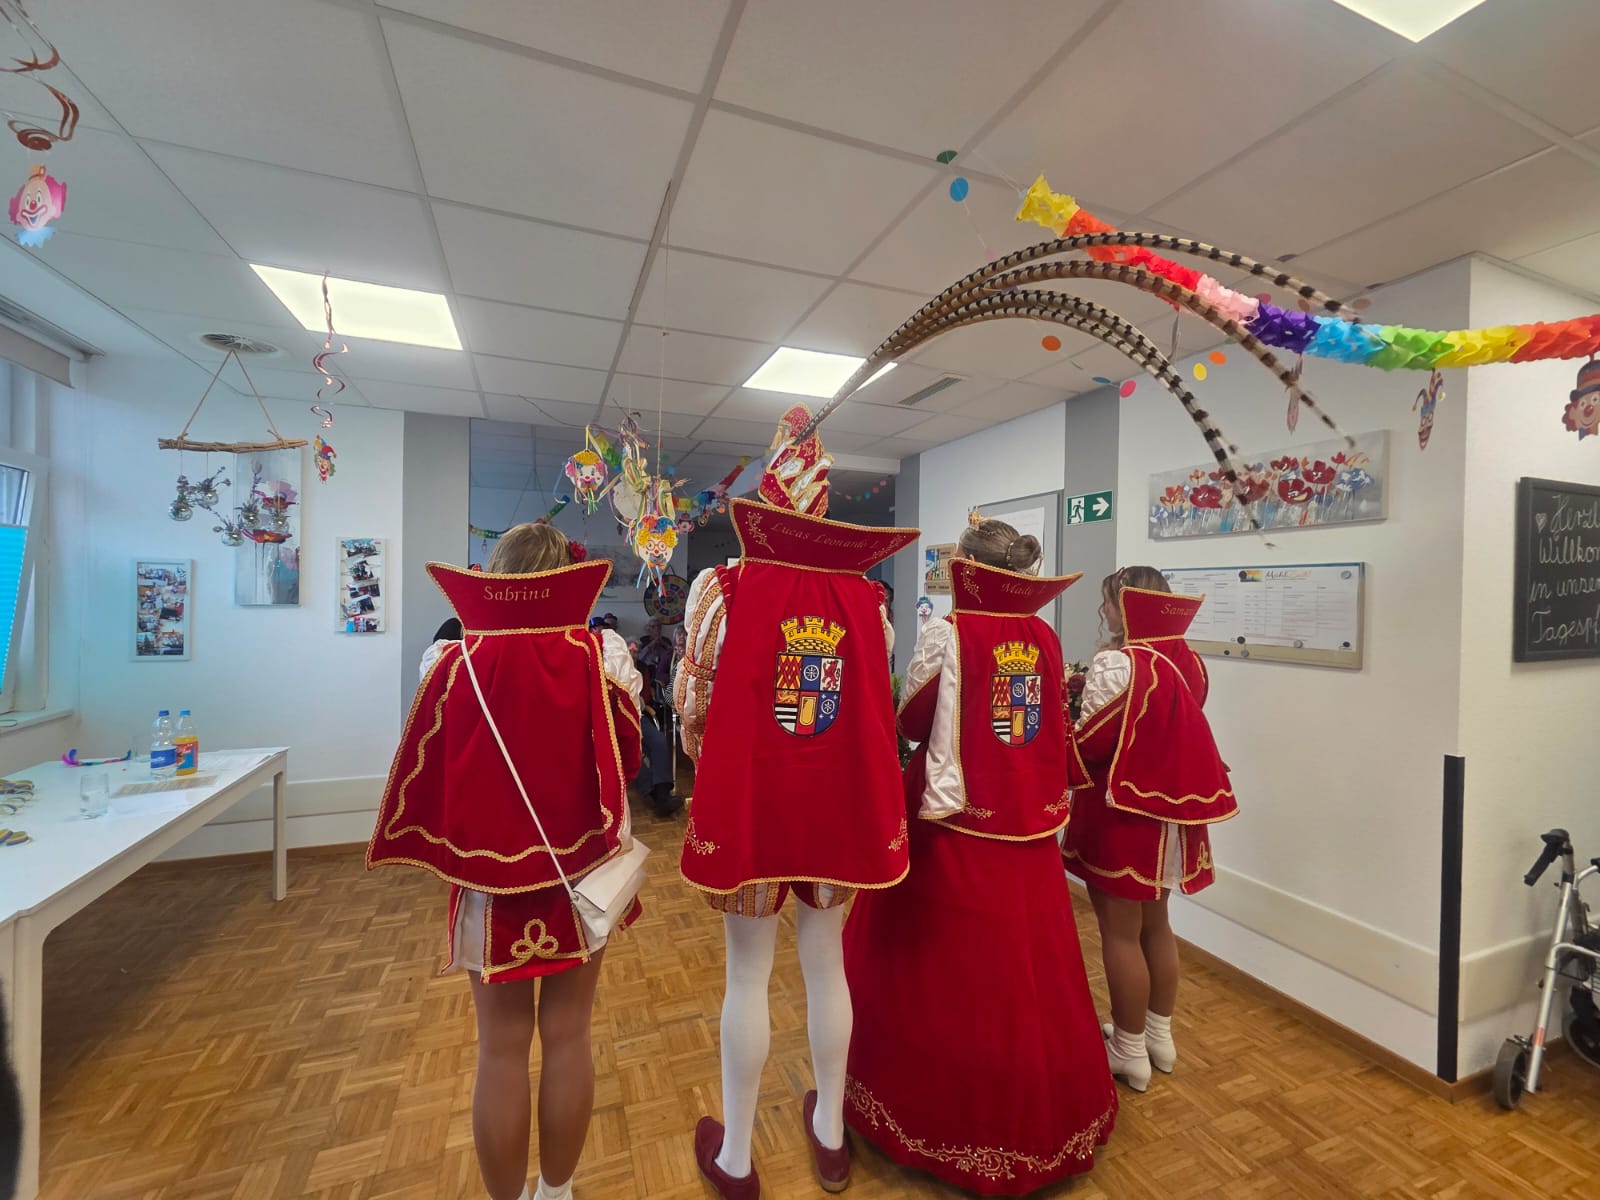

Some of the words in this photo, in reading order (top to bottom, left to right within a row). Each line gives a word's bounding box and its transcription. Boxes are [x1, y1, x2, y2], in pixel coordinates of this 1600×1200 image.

[1550, 494, 1600, 541] Herzl
[769, 522, 810, 540] Lucas
[483, 585, 551, 602] Sabrina
